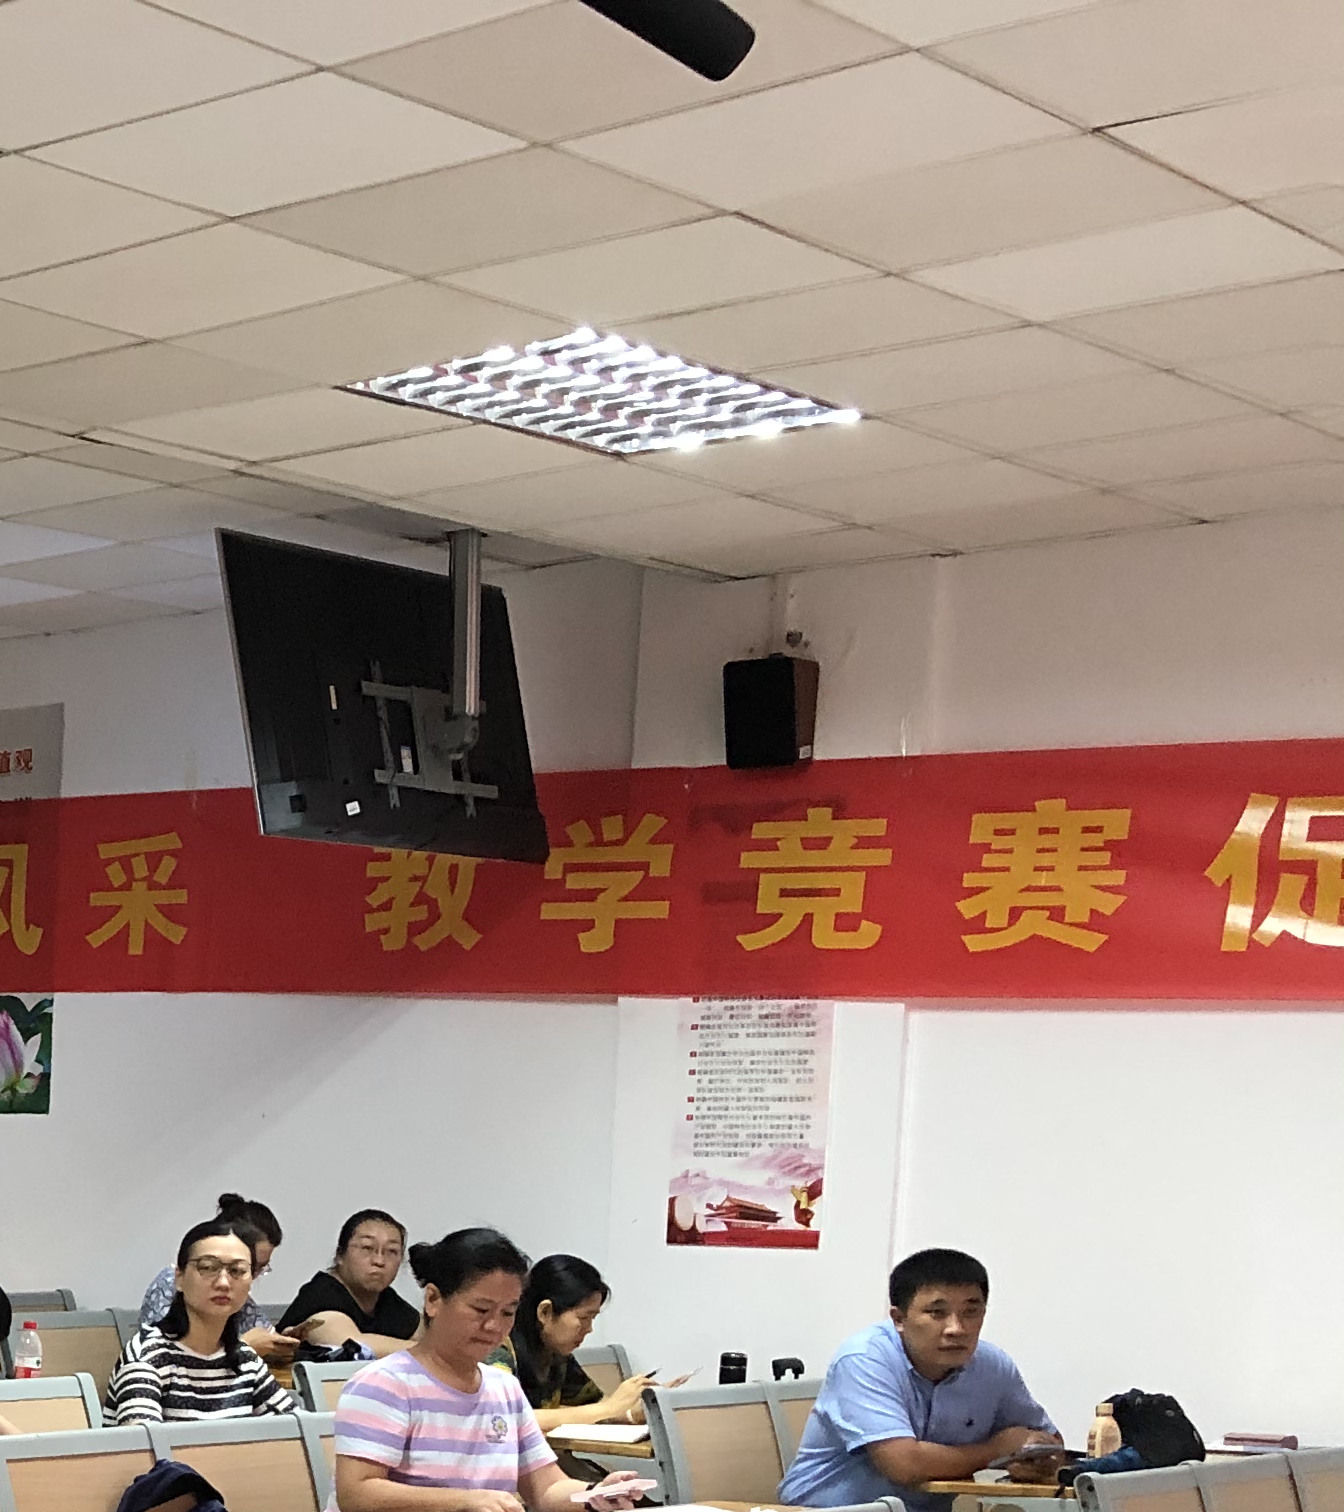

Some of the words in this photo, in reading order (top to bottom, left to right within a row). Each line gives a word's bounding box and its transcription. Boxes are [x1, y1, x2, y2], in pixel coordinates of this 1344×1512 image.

[365, 793, 1344, 953] 教学竞赛促
